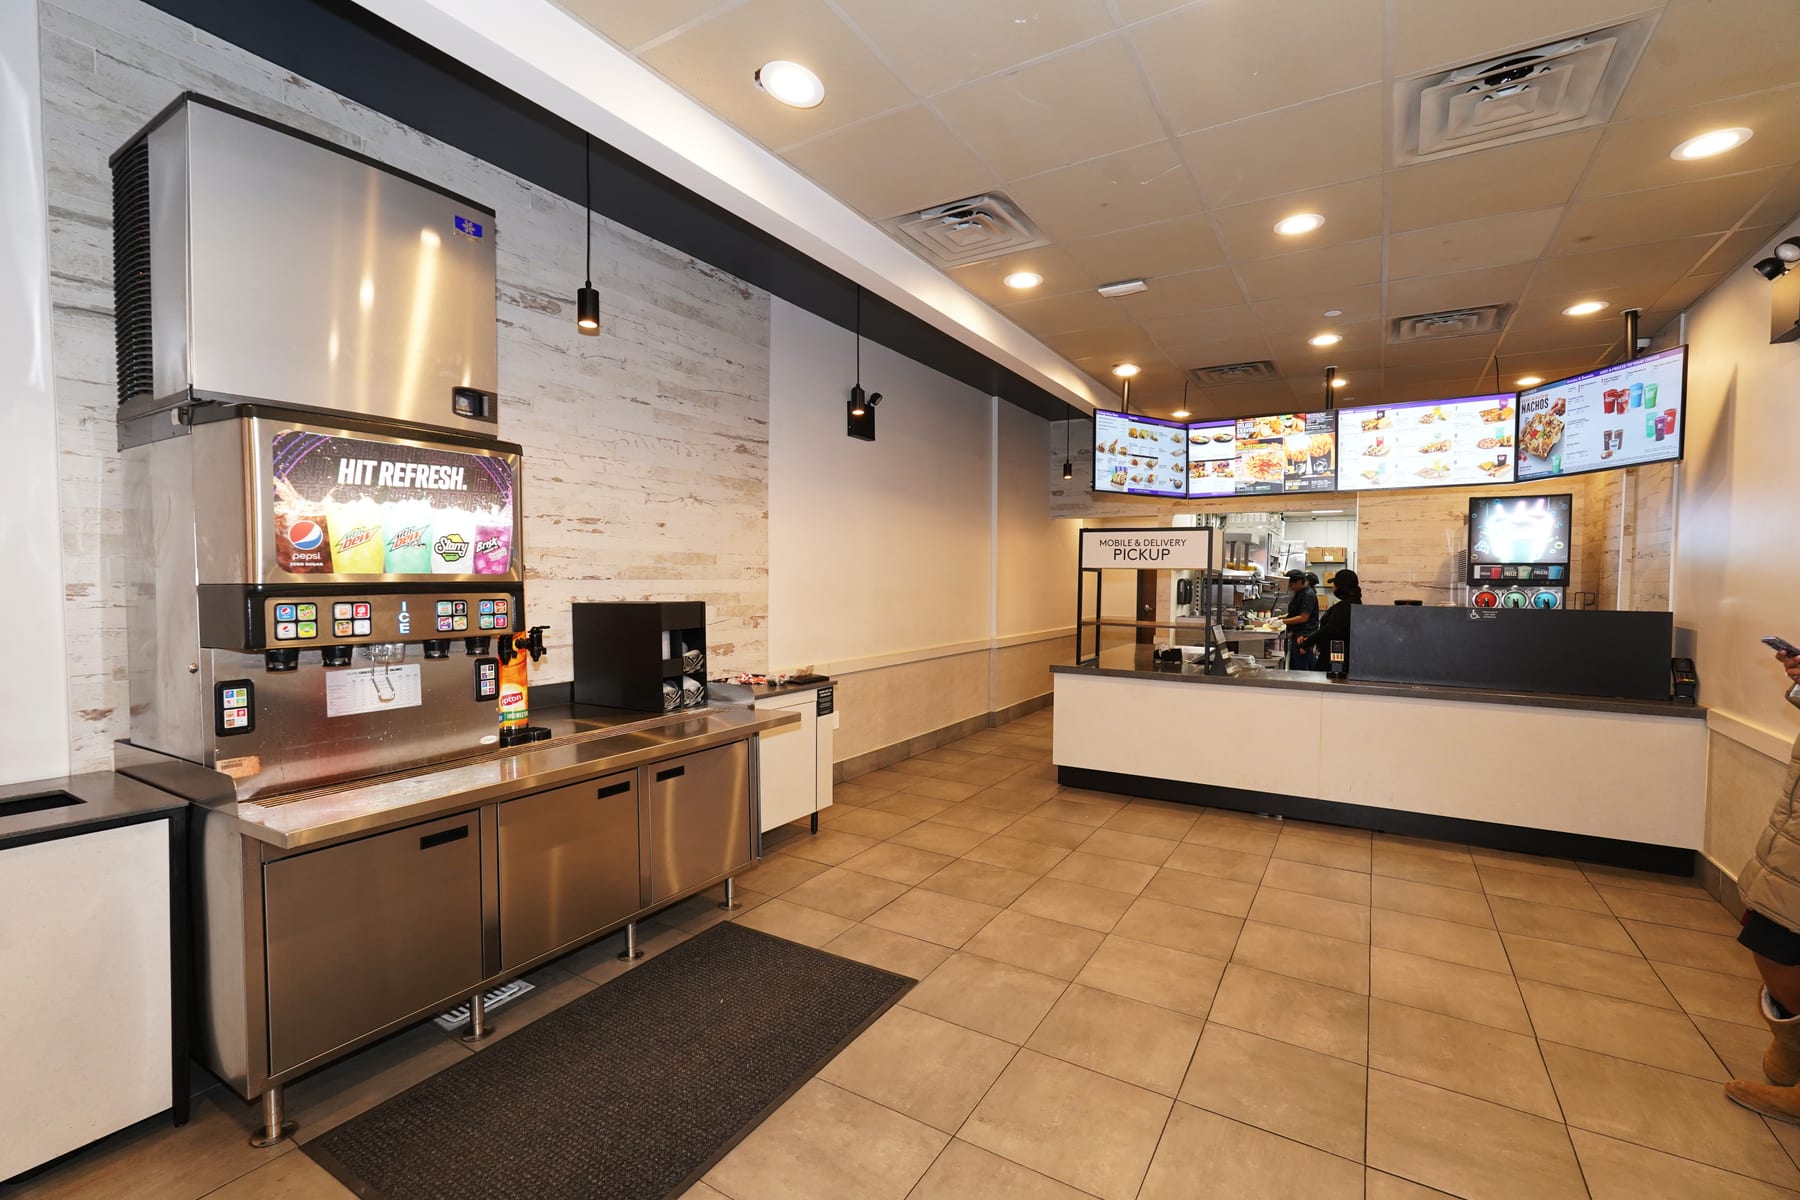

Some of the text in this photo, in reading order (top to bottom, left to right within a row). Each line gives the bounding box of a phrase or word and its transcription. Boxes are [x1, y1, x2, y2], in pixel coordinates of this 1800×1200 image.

[1521, 398, 1549, 414] NACHOS
[337, 457, 378, 486] HIT
[378, 461, 468, 490] REFRESH.
[434, 536, 469, 558] Starry
[1099, 539, 1186, 547] MOBILE & DELIVERY
[292, 552, 322, 561] pepsi
[1113, 548, 1171, 561] PICKUP
[398, 601, 410, 634] ICE
